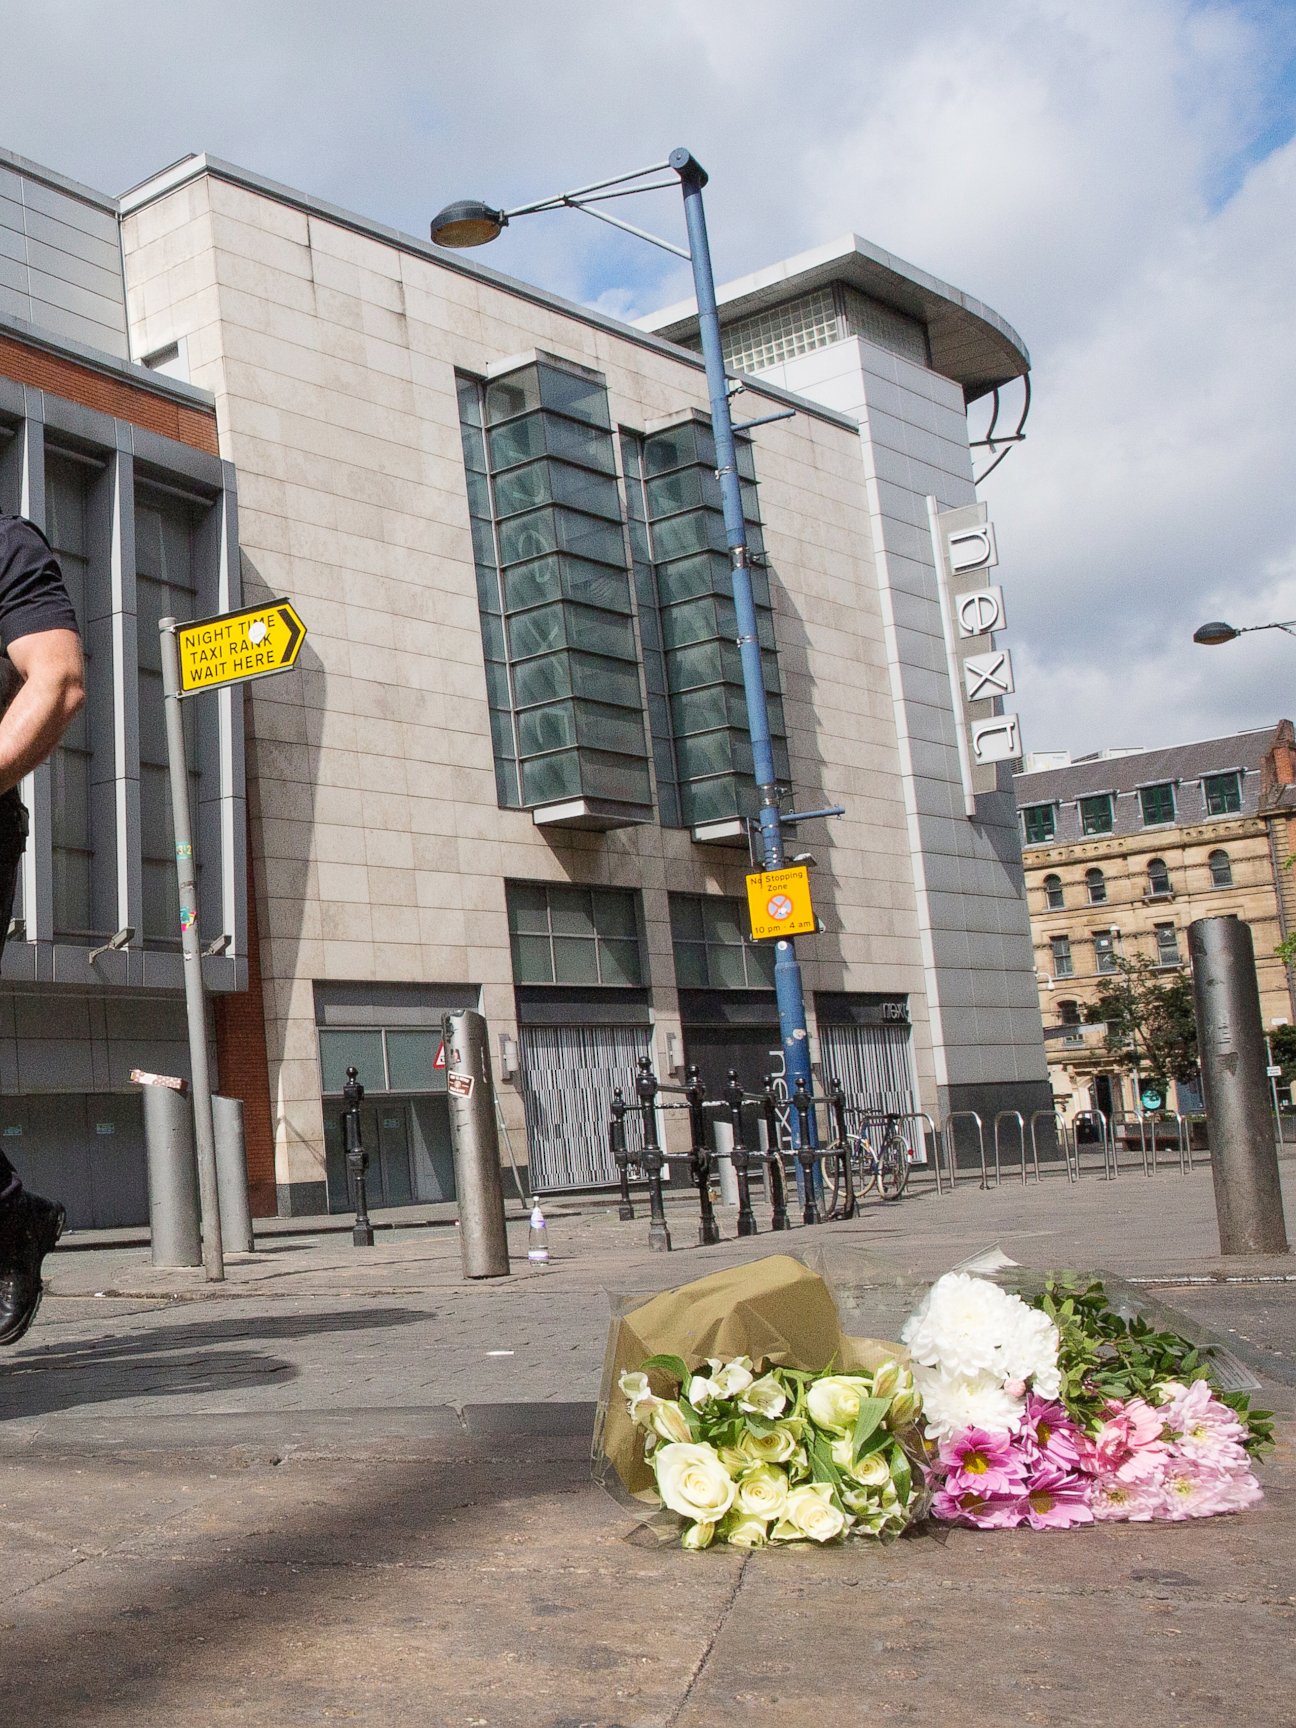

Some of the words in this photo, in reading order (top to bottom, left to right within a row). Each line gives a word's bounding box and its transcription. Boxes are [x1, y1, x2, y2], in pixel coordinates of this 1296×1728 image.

[185, 626, 233, 649] NIGHT
[950, 528, 1016, 756] next
[190, 646, 223, 664] TAXI
[190, 662, 227, 682] WAIT
[234, 650, 275, 672] HERE
[765, 872, 803, 883] Stopping
[767, 884, 788, 892] Zone
[755, 926, 765, 934] 10
[767, 925, 781, 933] pm
